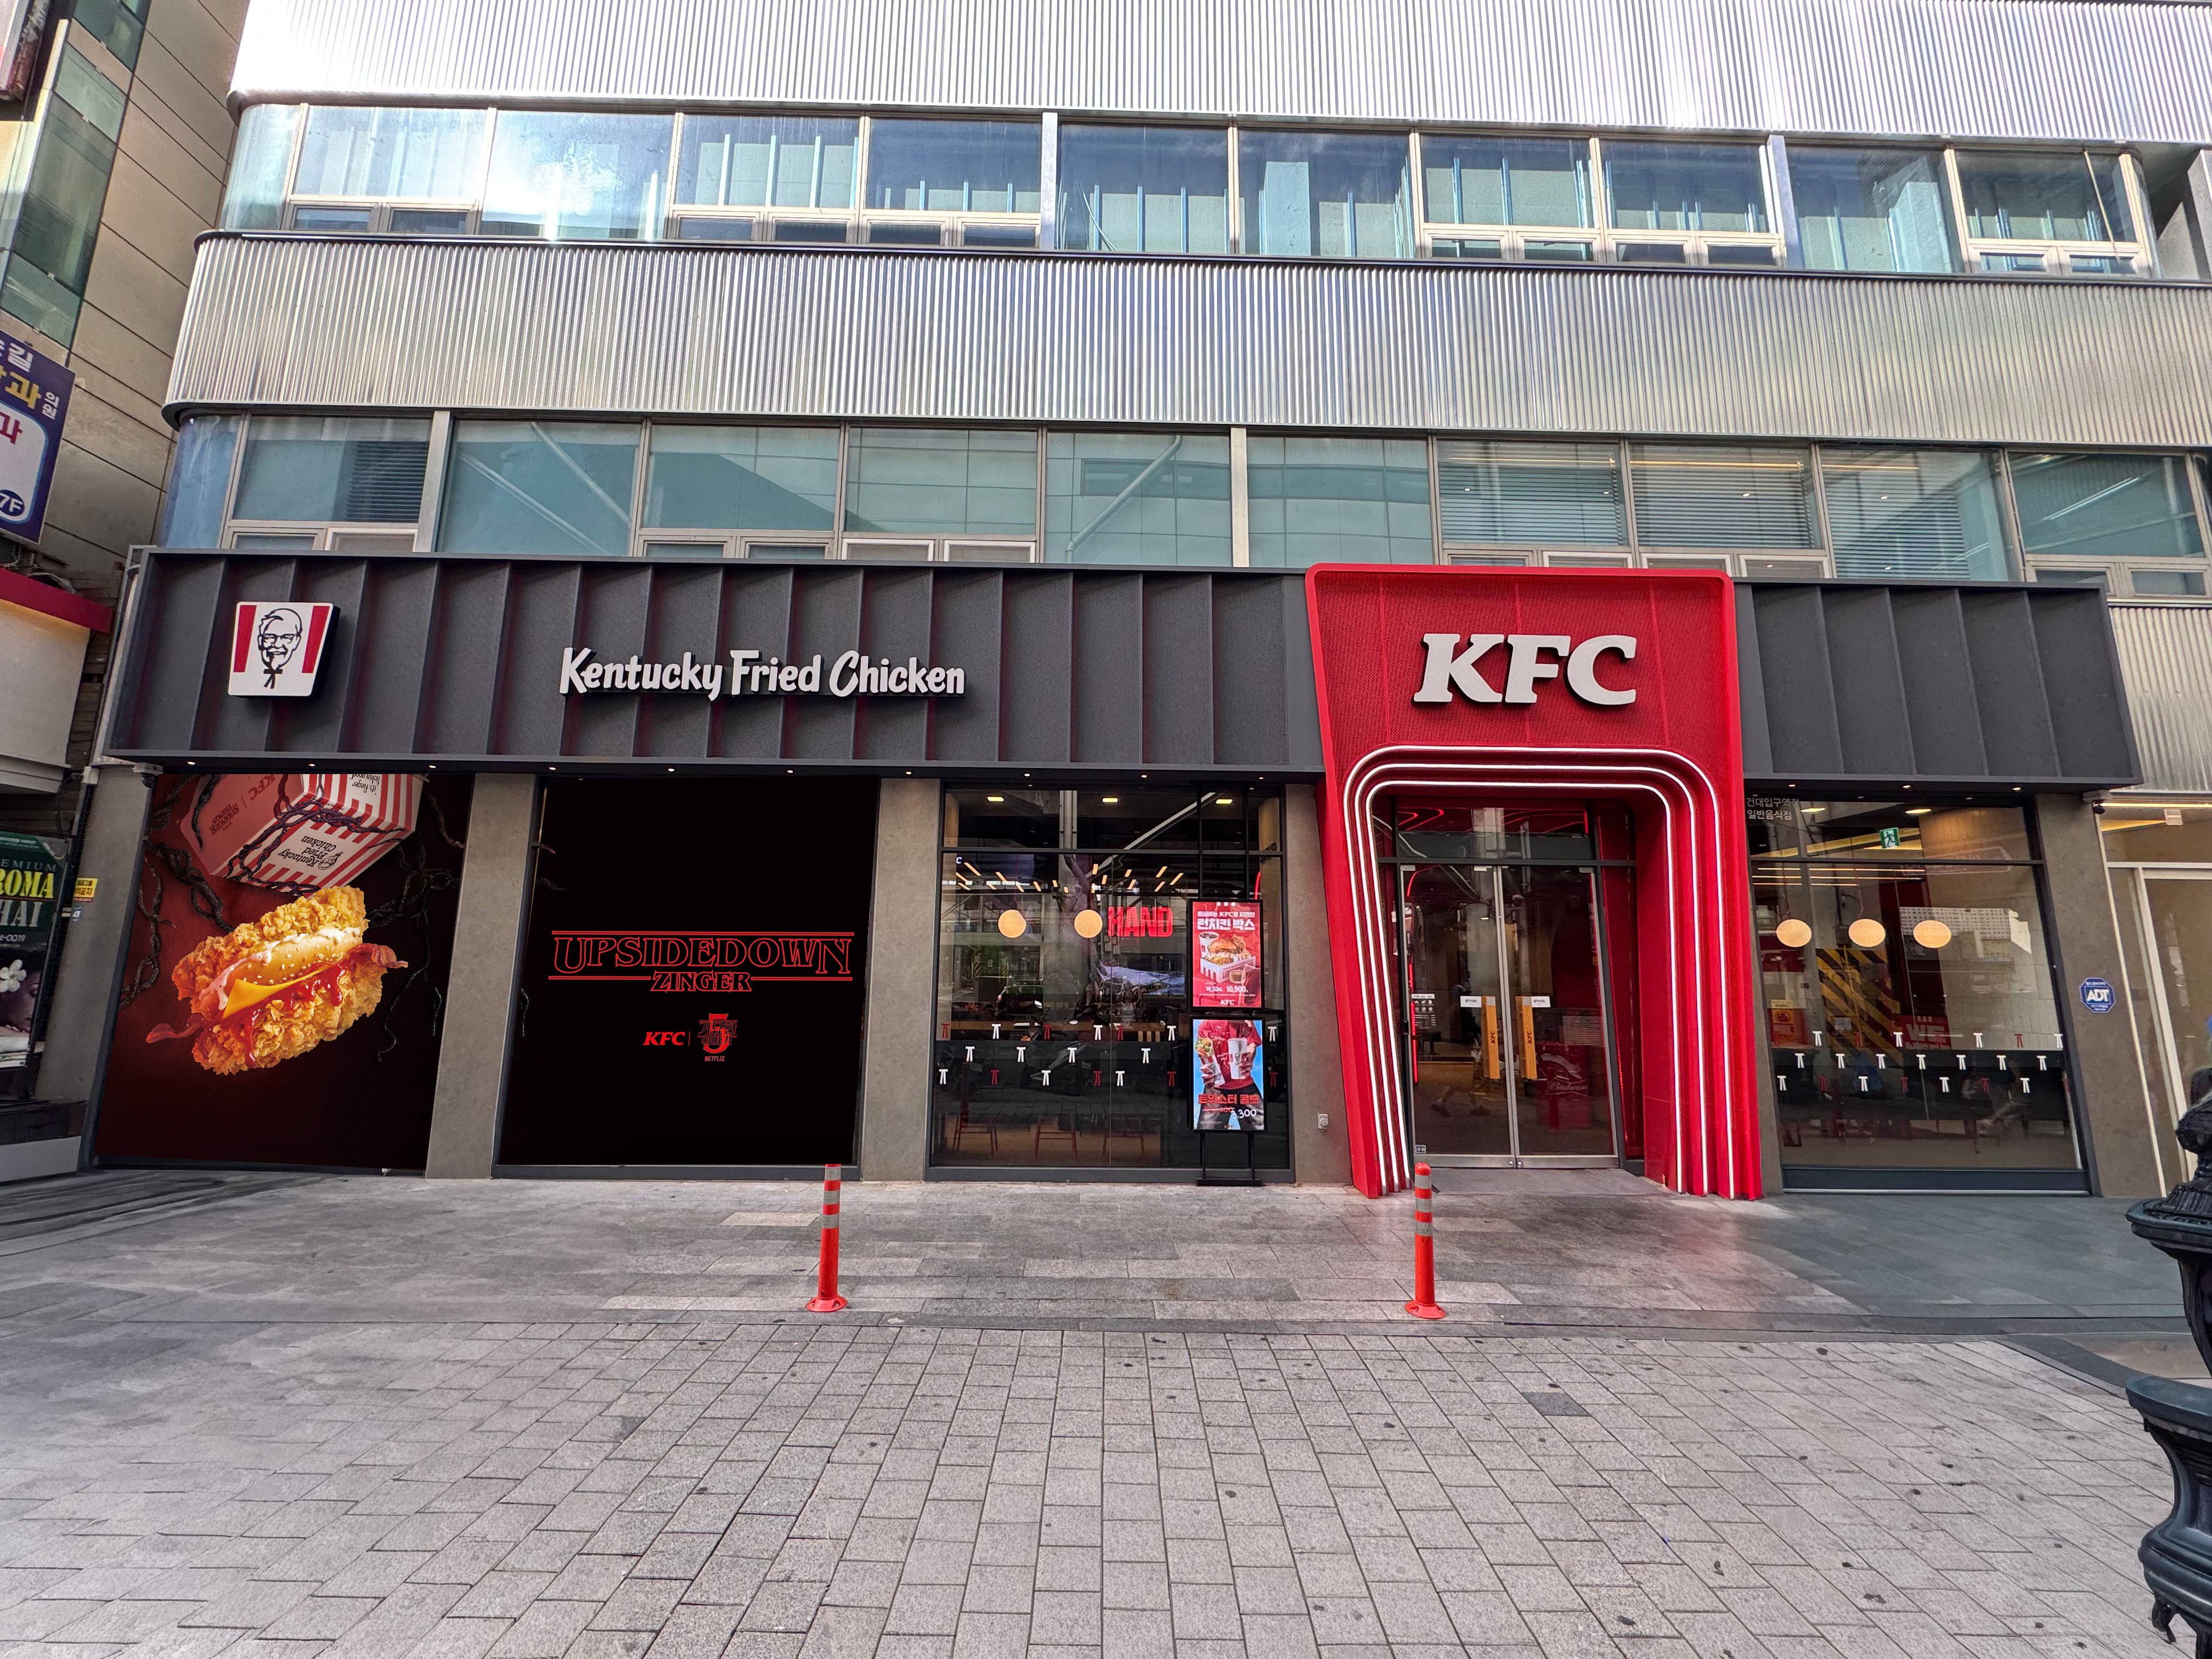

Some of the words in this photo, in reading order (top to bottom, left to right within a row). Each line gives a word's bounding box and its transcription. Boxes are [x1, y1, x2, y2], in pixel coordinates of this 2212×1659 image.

[0, 340, 33, 373] 길
[0, 364, 41, 409] 과
[42, 391, 60, 420] 의원
[0, 492, 23, 512] 7F
[560, 647, 723, 702] Kentucky
[730, 650, 821, 695] Fried
[830, 650, 965, 697] Chicken
[1414, 634, 1637, 705] KFC
[248, 774, 275, 801] KFC
[352, 780, 368, 793] finger
[210, 804, 240, 834] STRANGER
[212, 804, 231, 823] THINGS
[1747, 809, 1792, 820] 일반음식점
[301, 836, 337, 852] Chicken
[278, 849, 320, 867] Kentucky
[301, 847, 329, 860] Fried
[1108, 906, 1173, 937] HAND
[1198, 918, 1231, 930] 런치킨
[1233, 918, 1255, 930] 박스
[554, 937, 851, 974] UPSIDEDOWN
[650, 970, 752, 992] ZINGER
[2086, 989, 2109, 1001] ADT
[698, 1020, 737, 1035] 기묘한
[643, 1032, 685, 1045] KFC
[702, 1035, 732, 1046] 이야기
[1198, 1094, 1237, 1104] 트위스터
